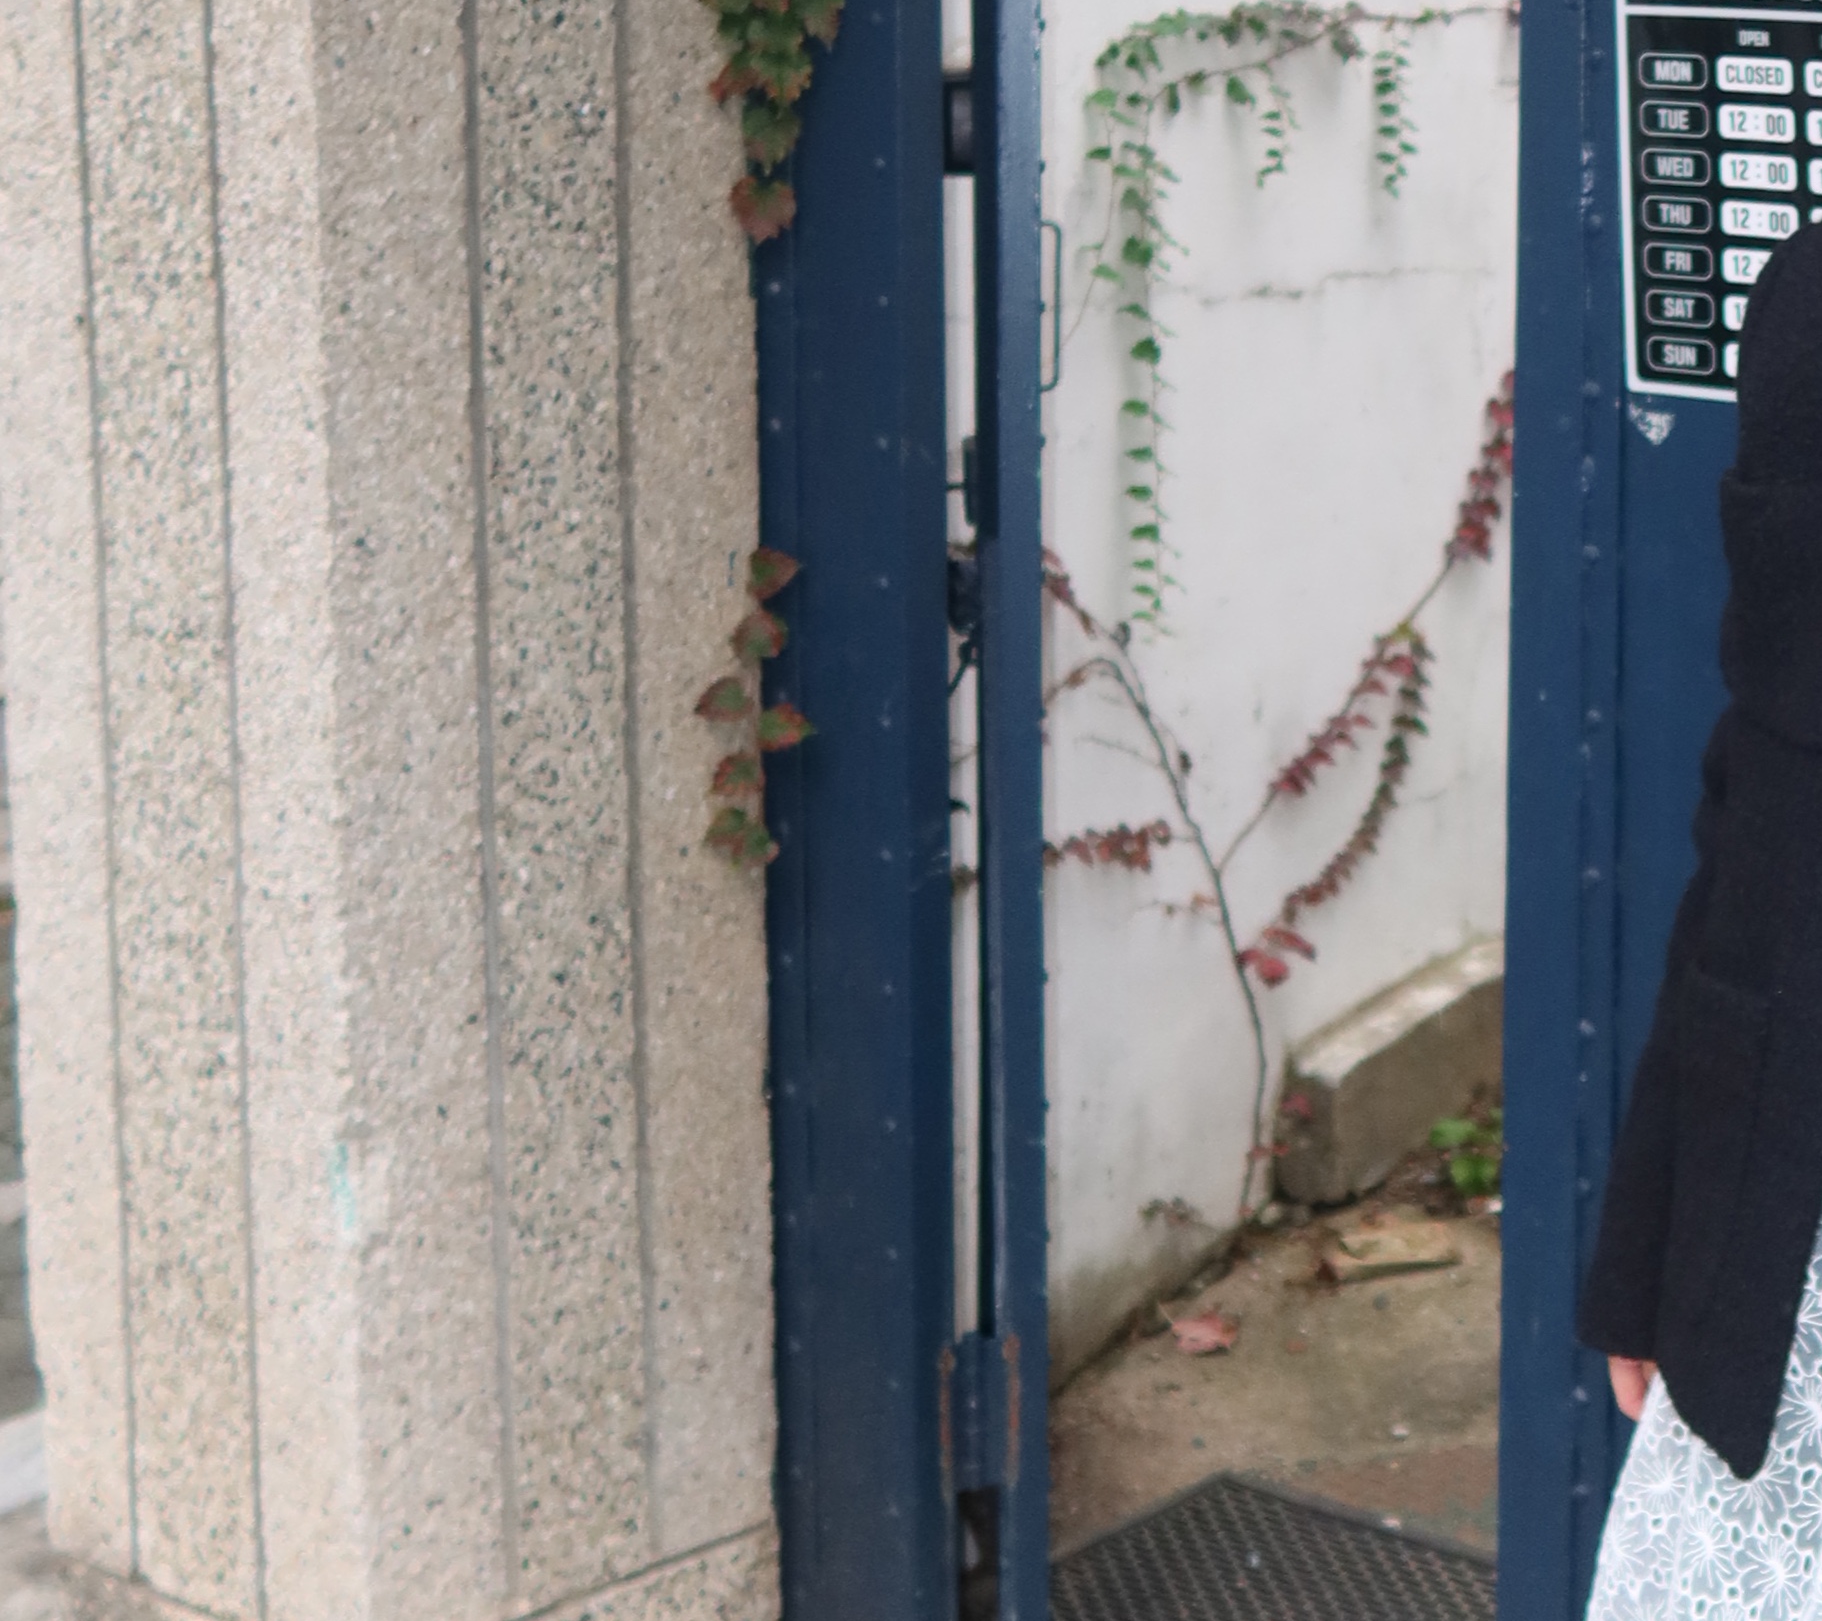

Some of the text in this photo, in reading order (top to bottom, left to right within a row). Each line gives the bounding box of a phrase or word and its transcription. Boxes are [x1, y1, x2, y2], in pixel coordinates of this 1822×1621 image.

[1737, 29, 1771, 48] OPEN
[1653, 59, 1694, 83] MON
[1725, 64, 1785, 87] CLOSED
[1656, 108, 1691, 131] TUE
[1655, 156, 1695, 178] WED
[1658, 203, 1693, 227] THU
[1663, 249, 1693, 272] FRI
[1662, 296, 1696, 320] SAT
[1662, 343, 1698, 367] SUN
